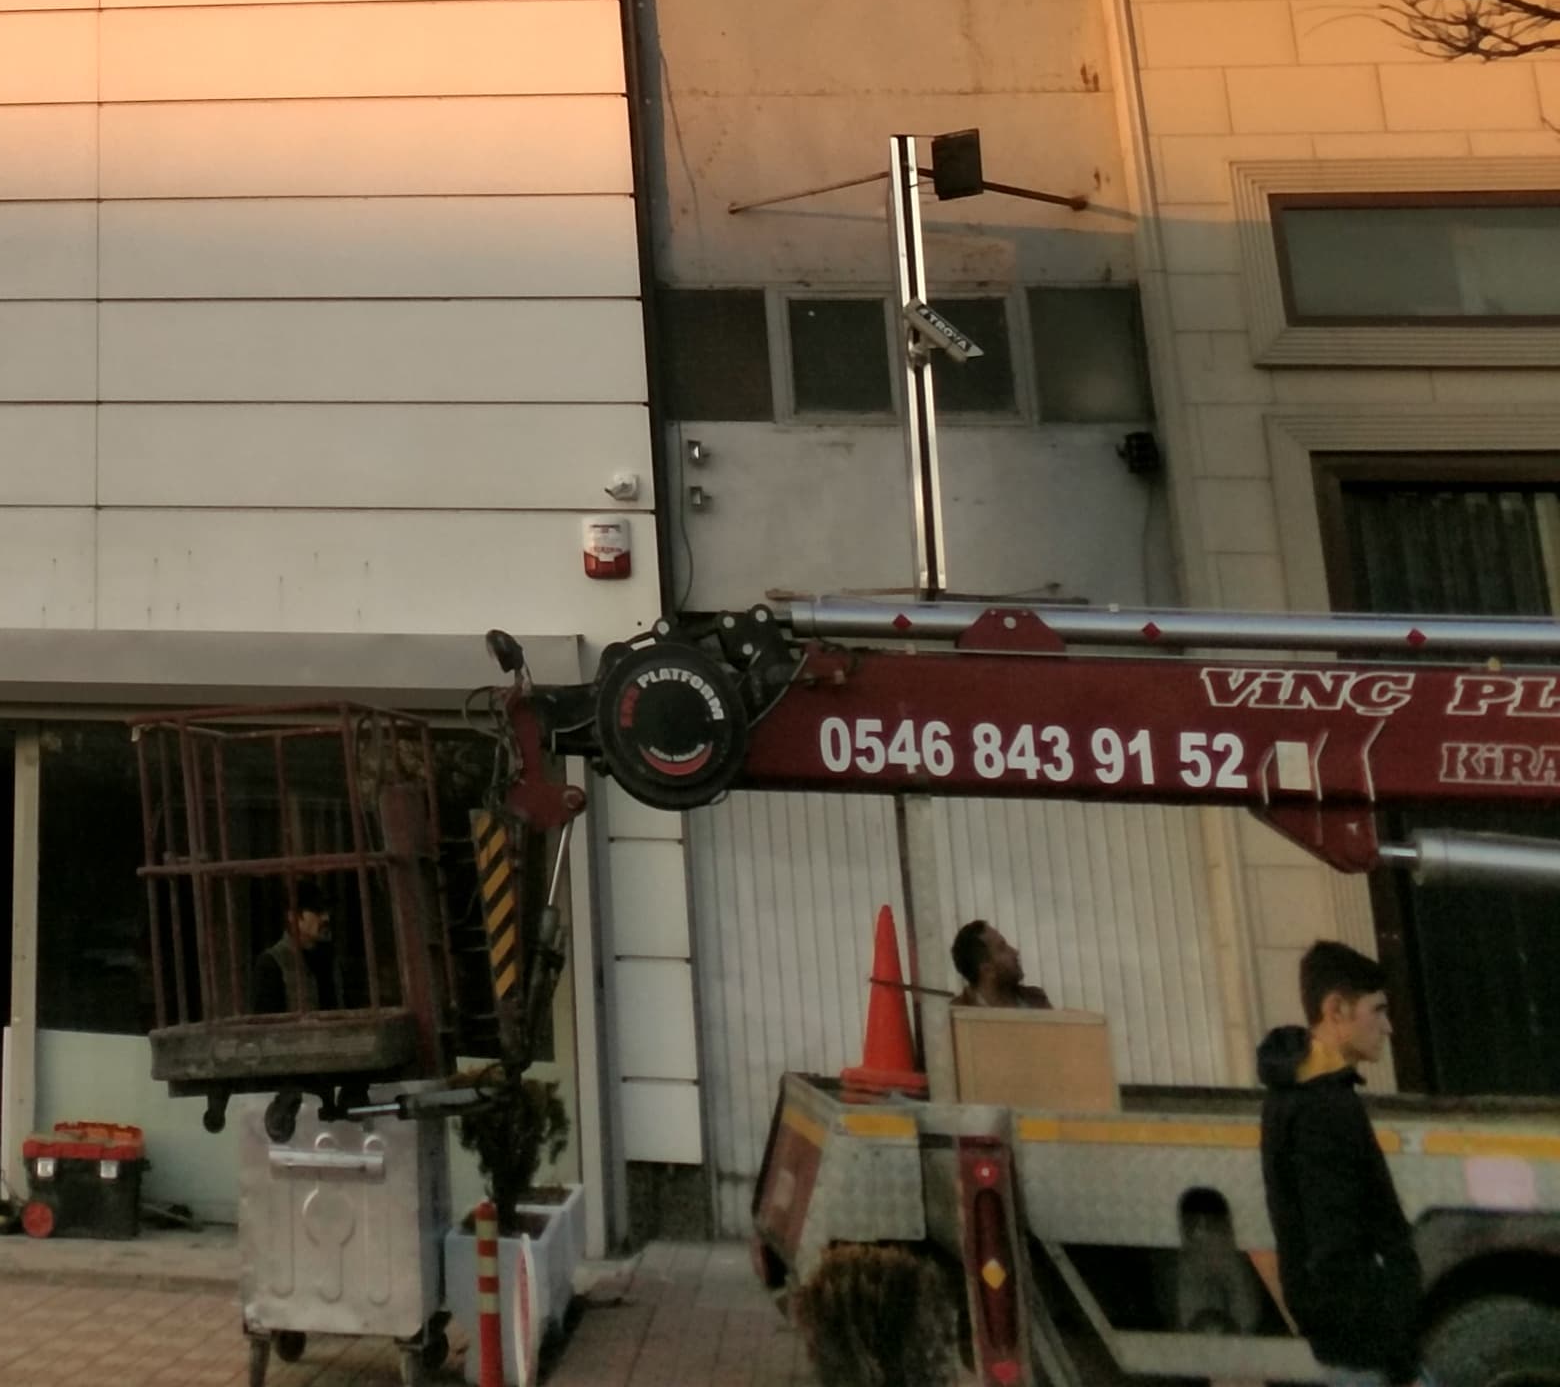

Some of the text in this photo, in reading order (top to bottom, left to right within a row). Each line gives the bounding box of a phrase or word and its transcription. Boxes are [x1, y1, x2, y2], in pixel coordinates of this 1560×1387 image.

[636, 667, 725, 721] PLATFORM
[819, 717, 1248, 789] 0546 843 91 52
